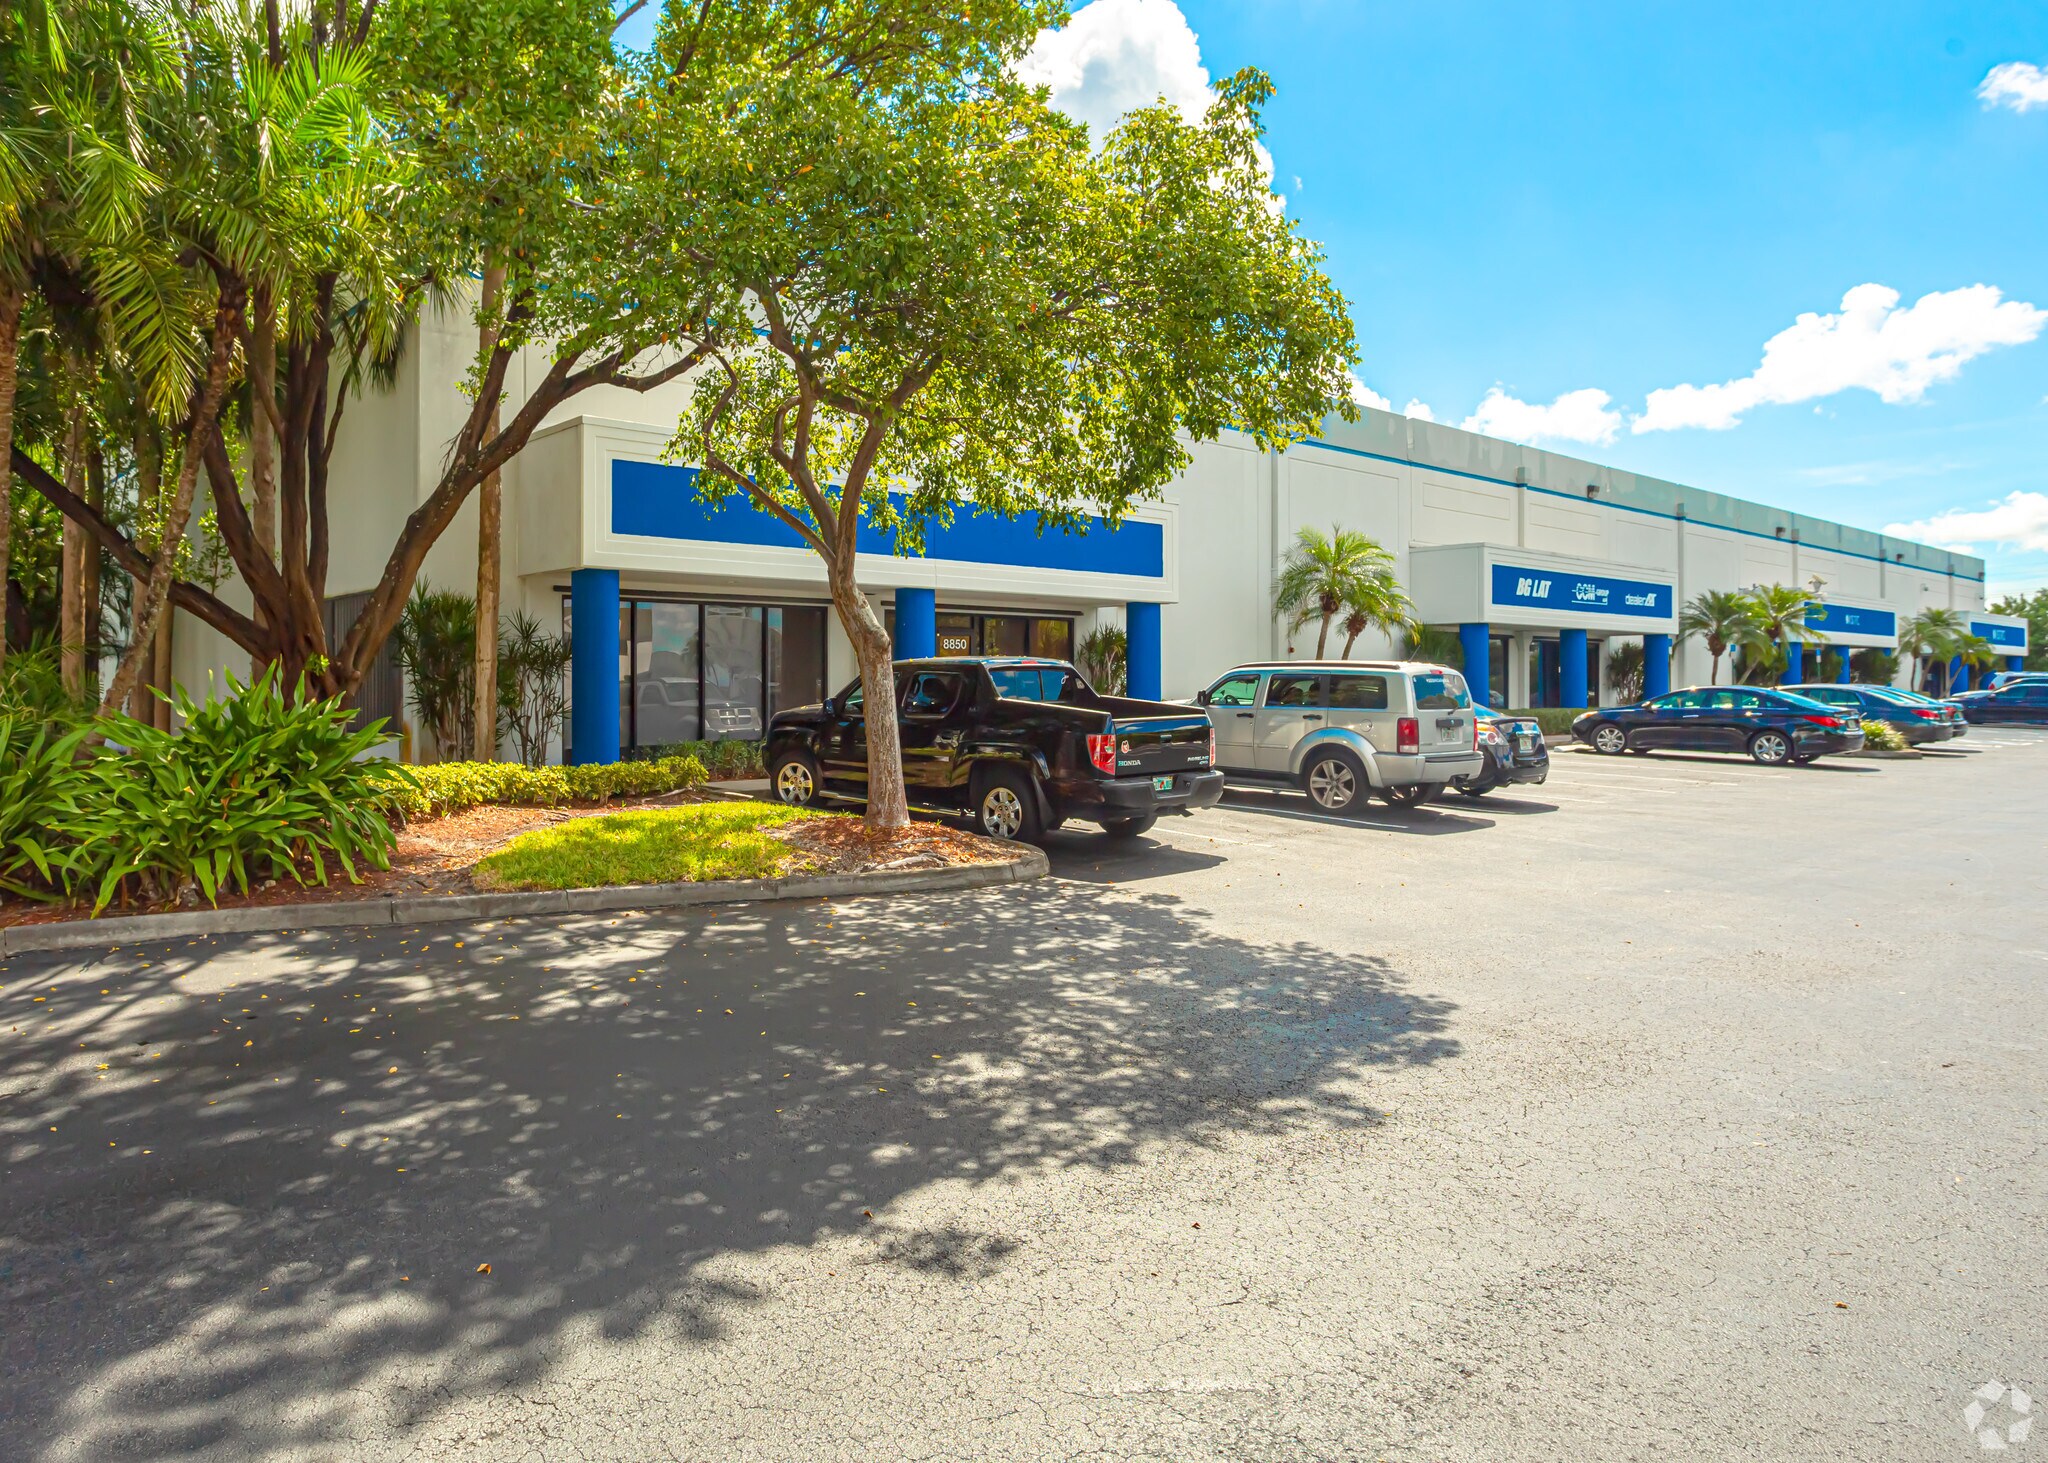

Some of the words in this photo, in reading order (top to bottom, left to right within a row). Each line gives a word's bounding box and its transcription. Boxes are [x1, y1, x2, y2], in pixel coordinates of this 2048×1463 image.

[1516, 577, 1531, 596] BG
[1532, 580, 1551, 598] LAT
[943, 639, 966, 649] 8850
